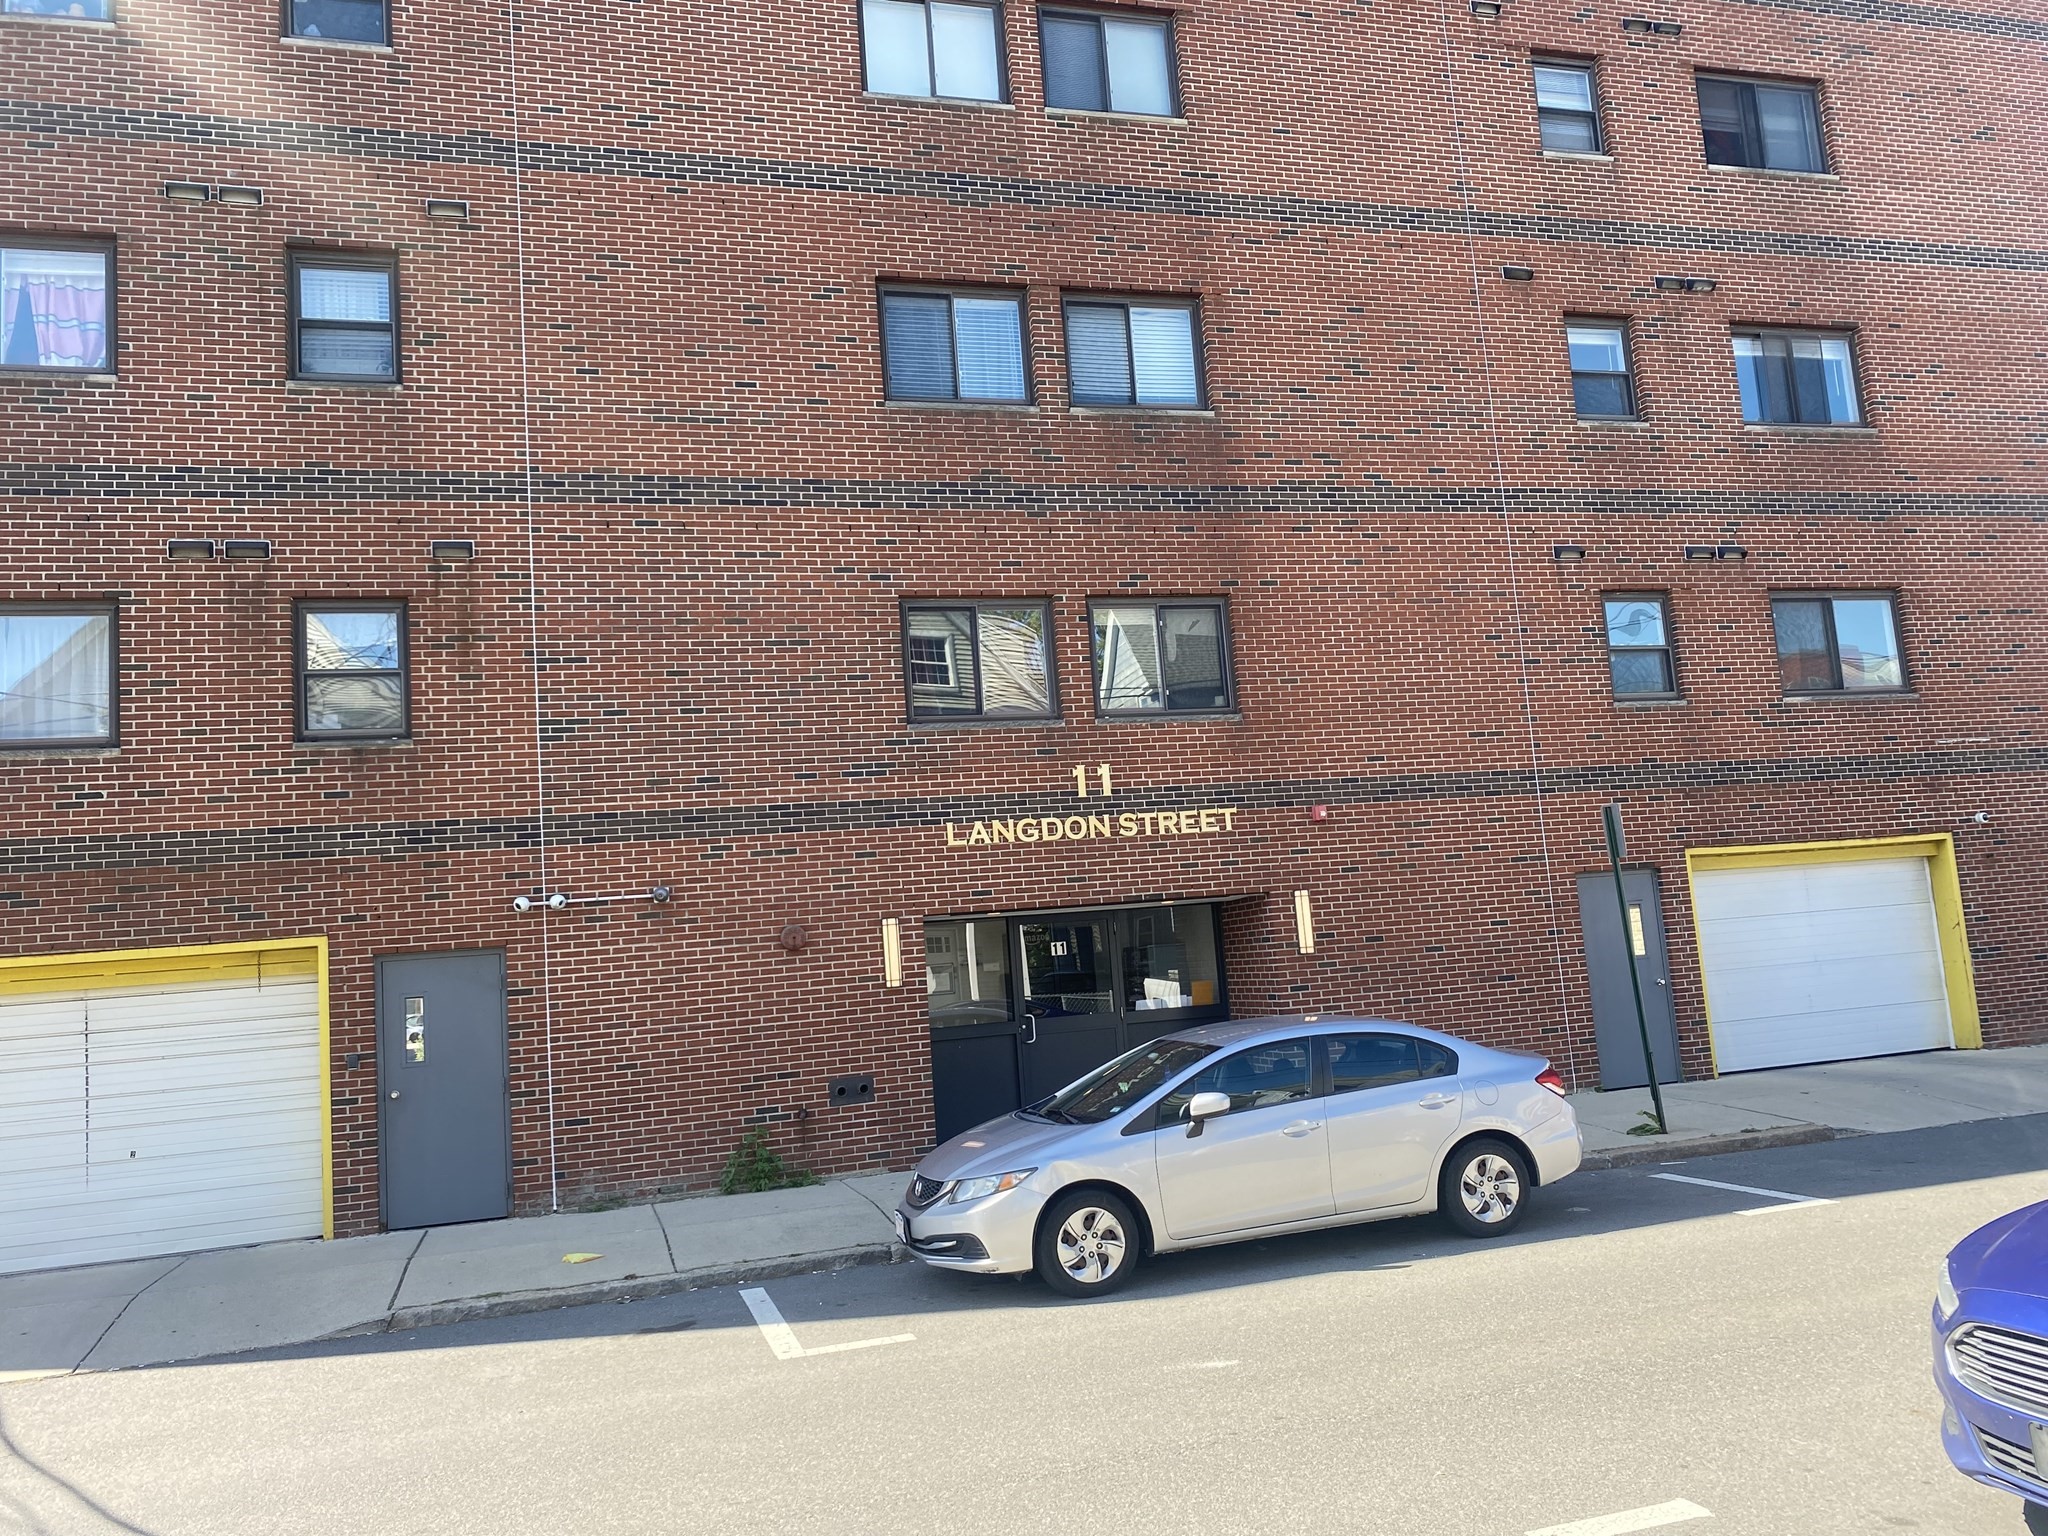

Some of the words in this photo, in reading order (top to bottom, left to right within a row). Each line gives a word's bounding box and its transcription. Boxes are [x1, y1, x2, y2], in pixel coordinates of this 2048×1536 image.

[1072, 763, 1113, 798] 11
[945, 814, 1112, 846] LANGDON
[1119, 807, 1238, 837] STREET
[1052, 942, 1066, 955] 11
